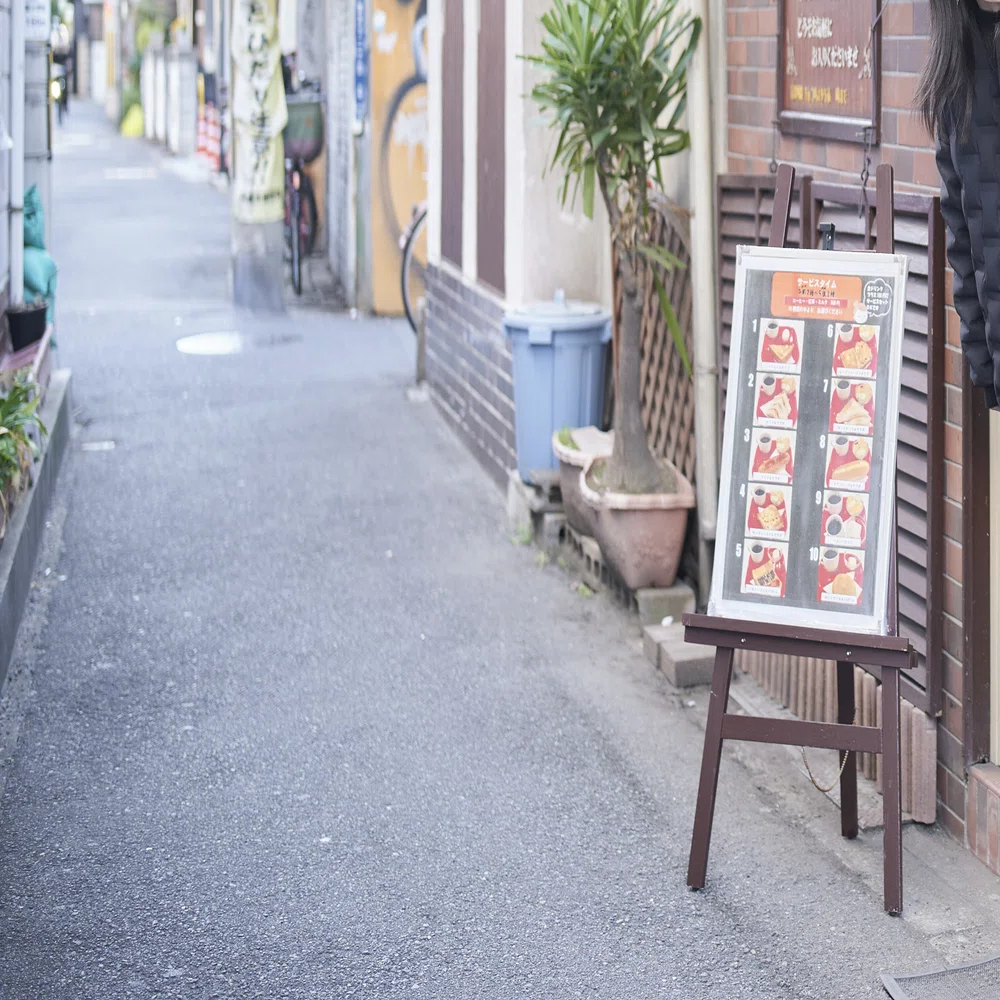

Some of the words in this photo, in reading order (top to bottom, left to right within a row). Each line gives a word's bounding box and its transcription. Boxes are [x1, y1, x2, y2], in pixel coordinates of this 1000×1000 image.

[797, 277, 837, 289] サービスタイム
[752, 318, 757, 333] 1
[827, 323, 834, 338] 6
[747, 372, 754, 388] 2
[823, 378, 829, 393] 7
[743, 427, 750, 443] 3
[819, 434, 826, 449] 8
[739, 483, 746, 498] 4
[815, 490, 822, 505] 9
[735, 542, 741, 558] 5
[809, 546, 819, 562] 10
